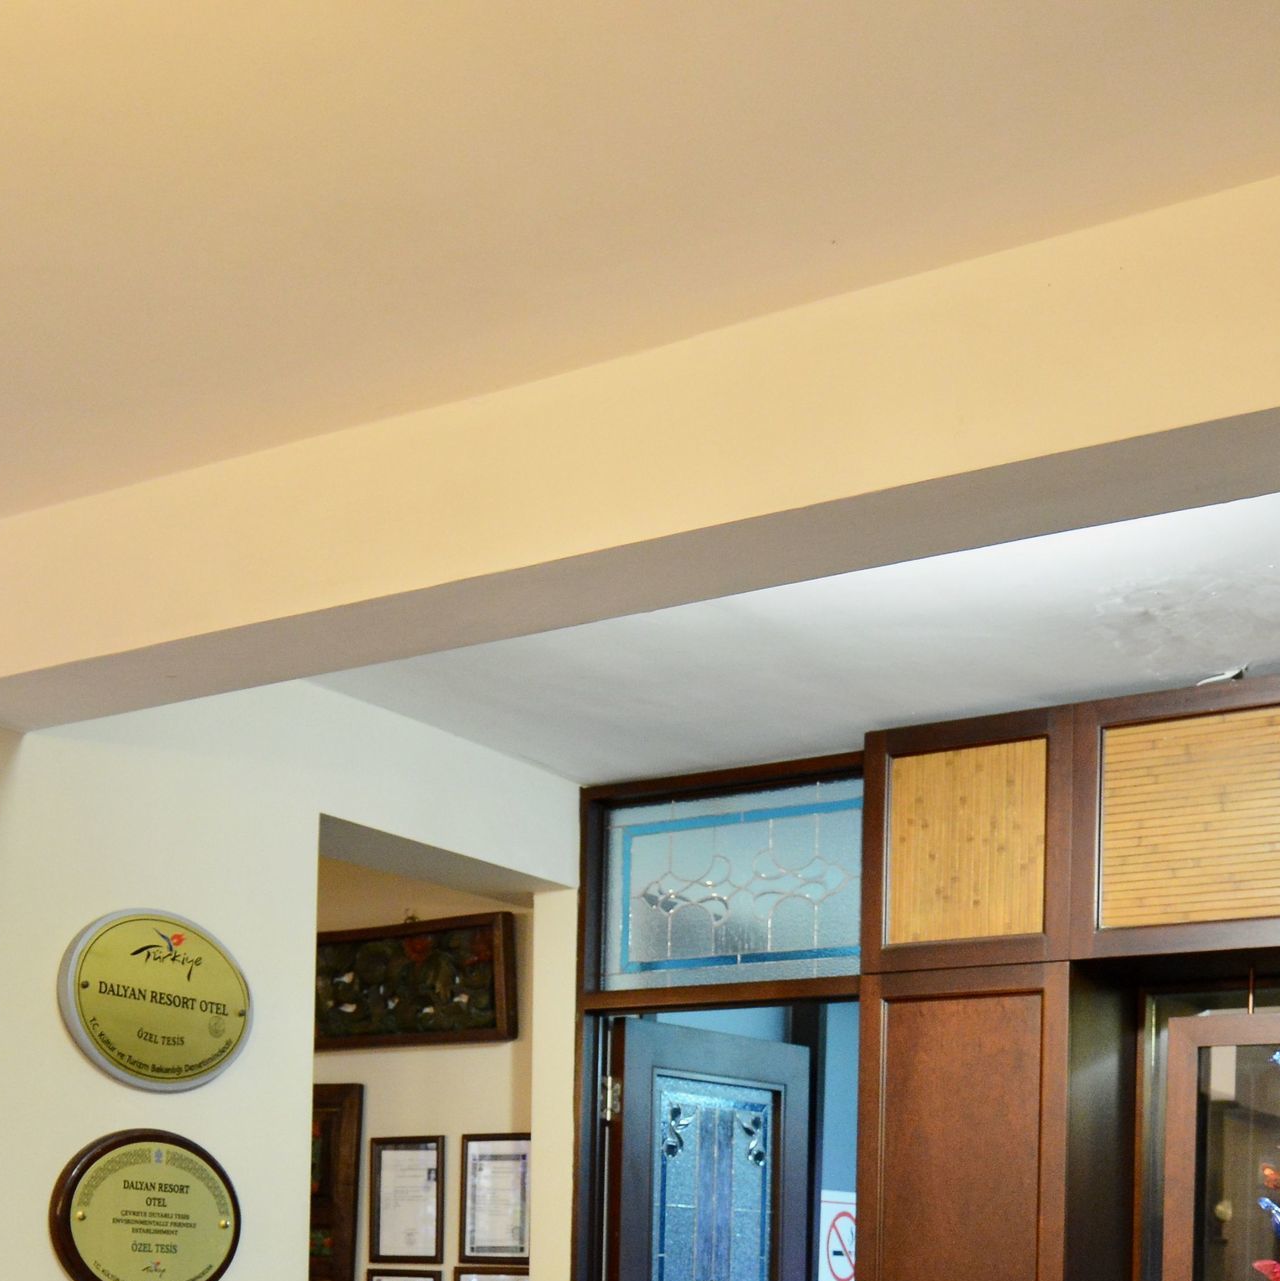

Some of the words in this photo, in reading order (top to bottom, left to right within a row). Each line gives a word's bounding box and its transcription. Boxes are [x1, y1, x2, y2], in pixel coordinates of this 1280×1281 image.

[98, 980, 147, 1001] DALYAN
[150, 990, 196, 1010] RESORT
[199, 1000, 229, 1016] OTEL
[137, 1027, 158, 1044] ÖZEL
[161, 1034, 185, 1046] TESİS
[123, 1180, 156, 1191] DALYAN
[158, 1182, 190, 1194] RESORT
[146, 1196, 167, 1207] OTEL
[131, 1240, 153, 1253] ÖZEL
